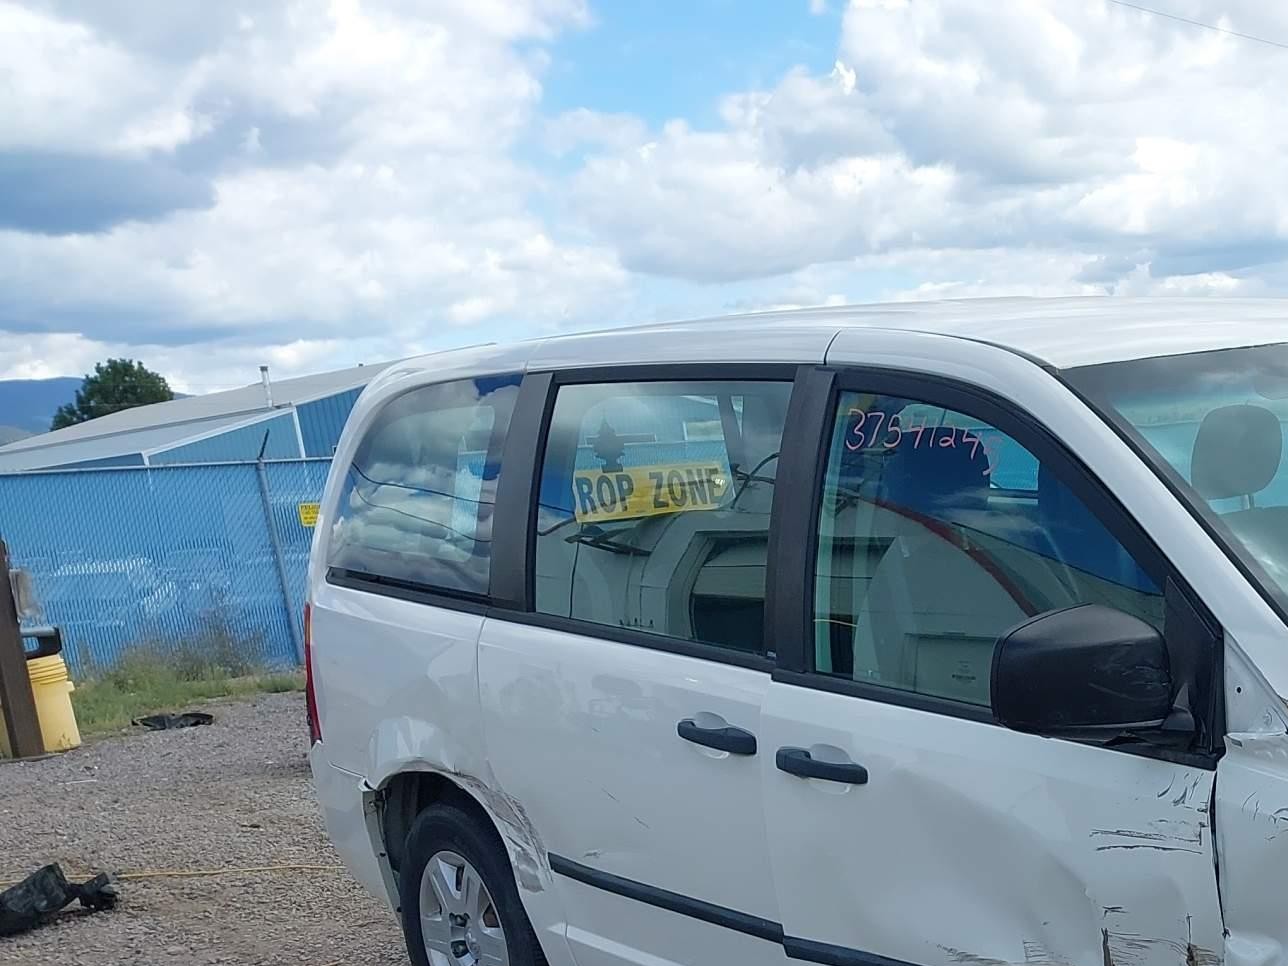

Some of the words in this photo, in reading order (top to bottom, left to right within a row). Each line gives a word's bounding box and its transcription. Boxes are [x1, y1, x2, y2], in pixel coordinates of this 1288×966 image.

[845, 407, 1004, 477] 37541245
[575, 473, 635, 516] ROP
[649, 466, 722, 509] ZONE
